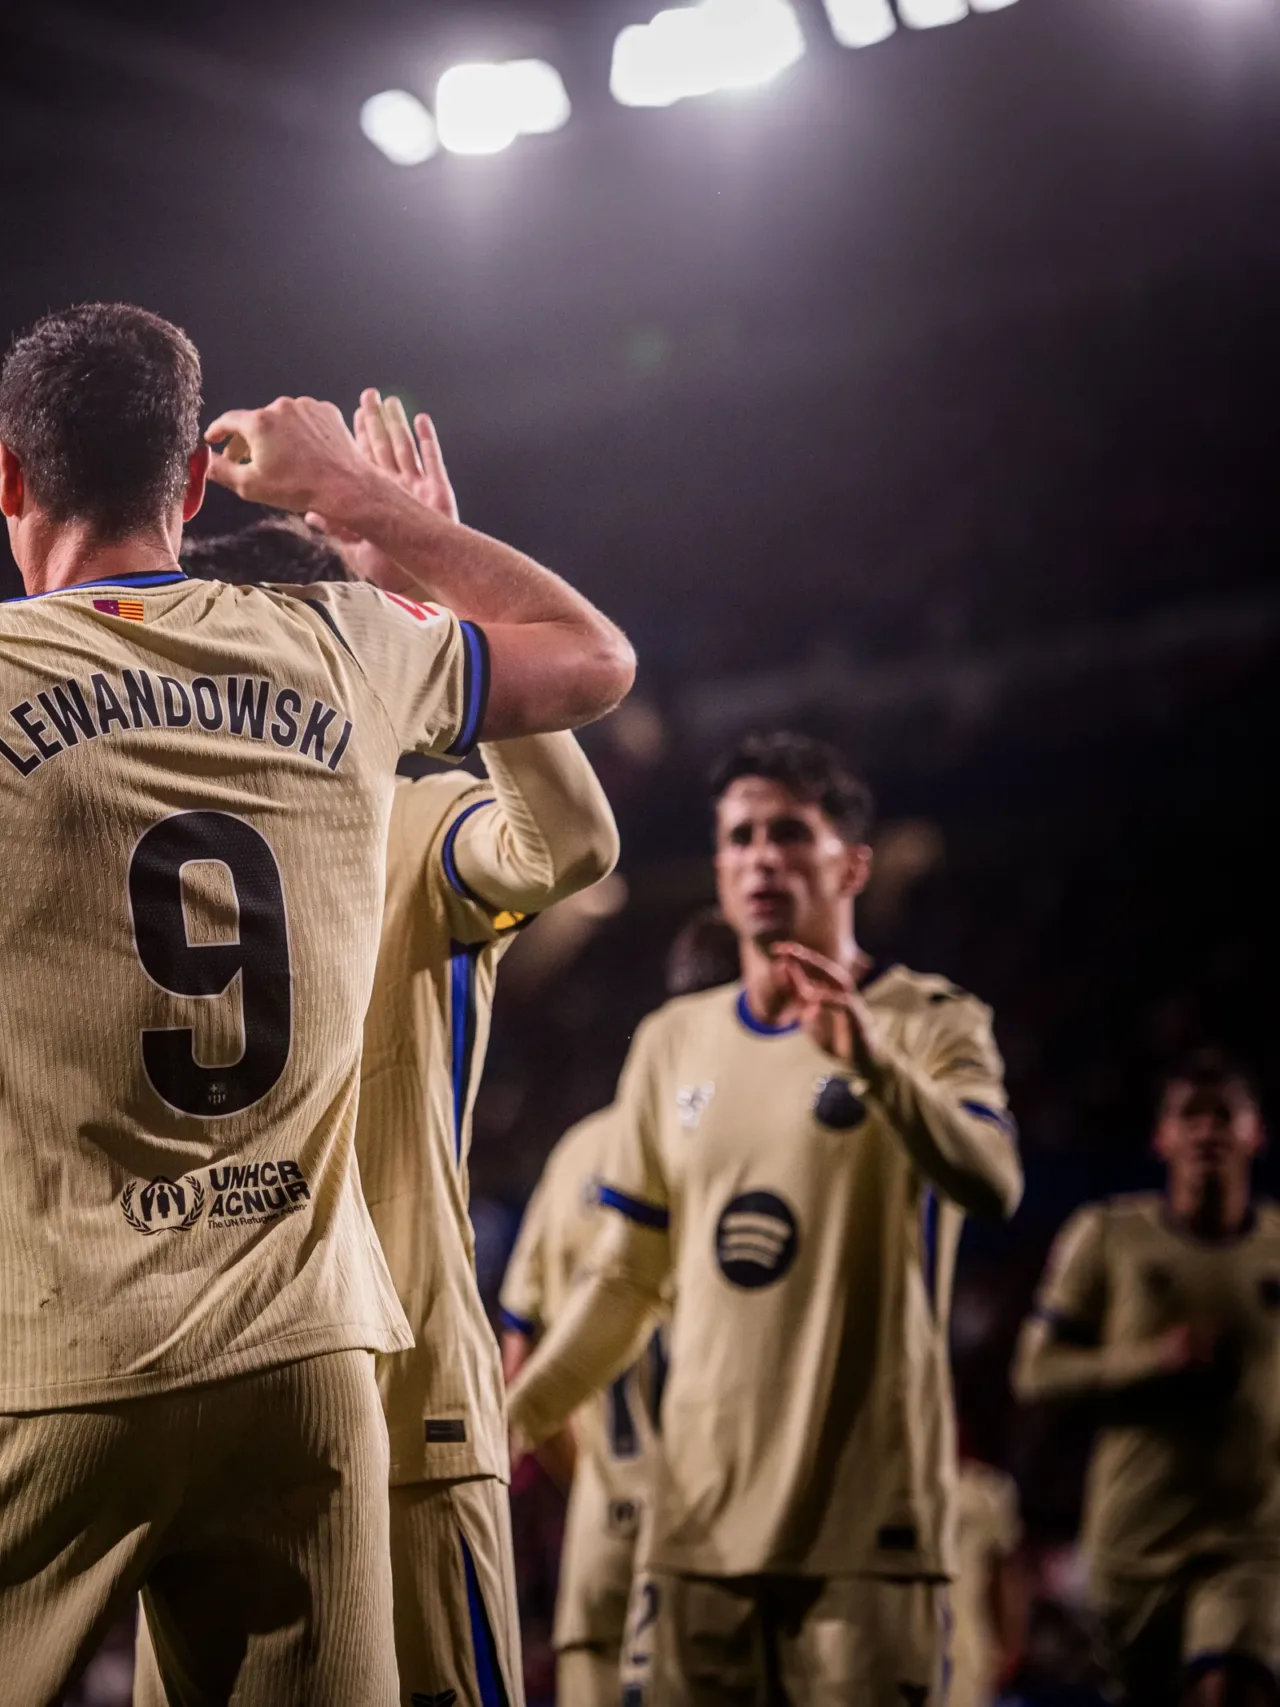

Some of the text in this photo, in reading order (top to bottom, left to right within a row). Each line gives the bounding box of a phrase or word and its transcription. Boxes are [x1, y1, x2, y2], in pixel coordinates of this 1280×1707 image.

[126, 809, 294, 1120] 9
[208, 1160, 304, 1191] UNHCR
[208, 1181, 312, 1217] ACNUR
[207, 1220, 223, 1230] The
[224, 1217, 239, 1229] UN
[240, 1211, 279, 1226] Refugee
